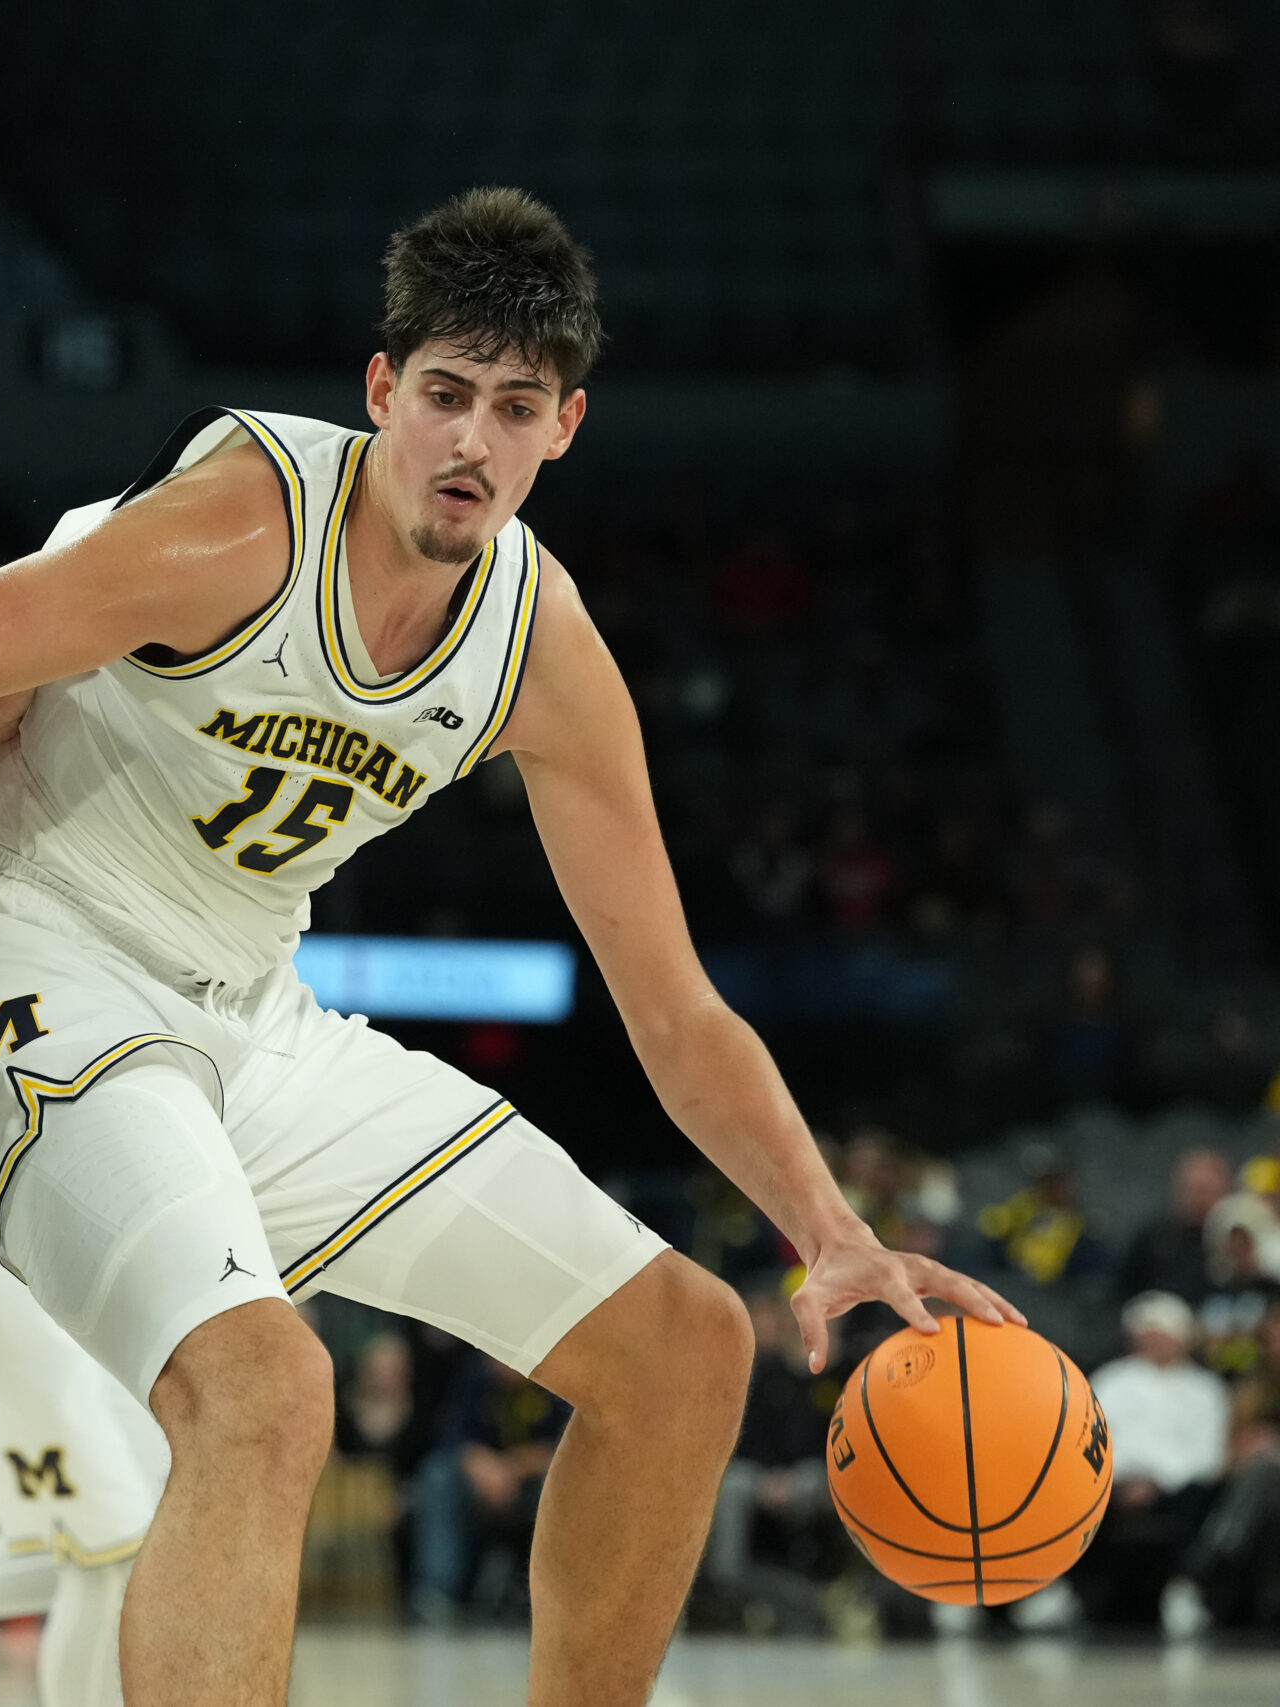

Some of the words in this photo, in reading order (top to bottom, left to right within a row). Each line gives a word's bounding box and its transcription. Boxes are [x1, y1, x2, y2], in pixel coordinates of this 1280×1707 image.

[197, 708, 428, 809] MICHIGAN
[191, 766, 355, 876] 15
[5, 1448, 75, 1498] M
